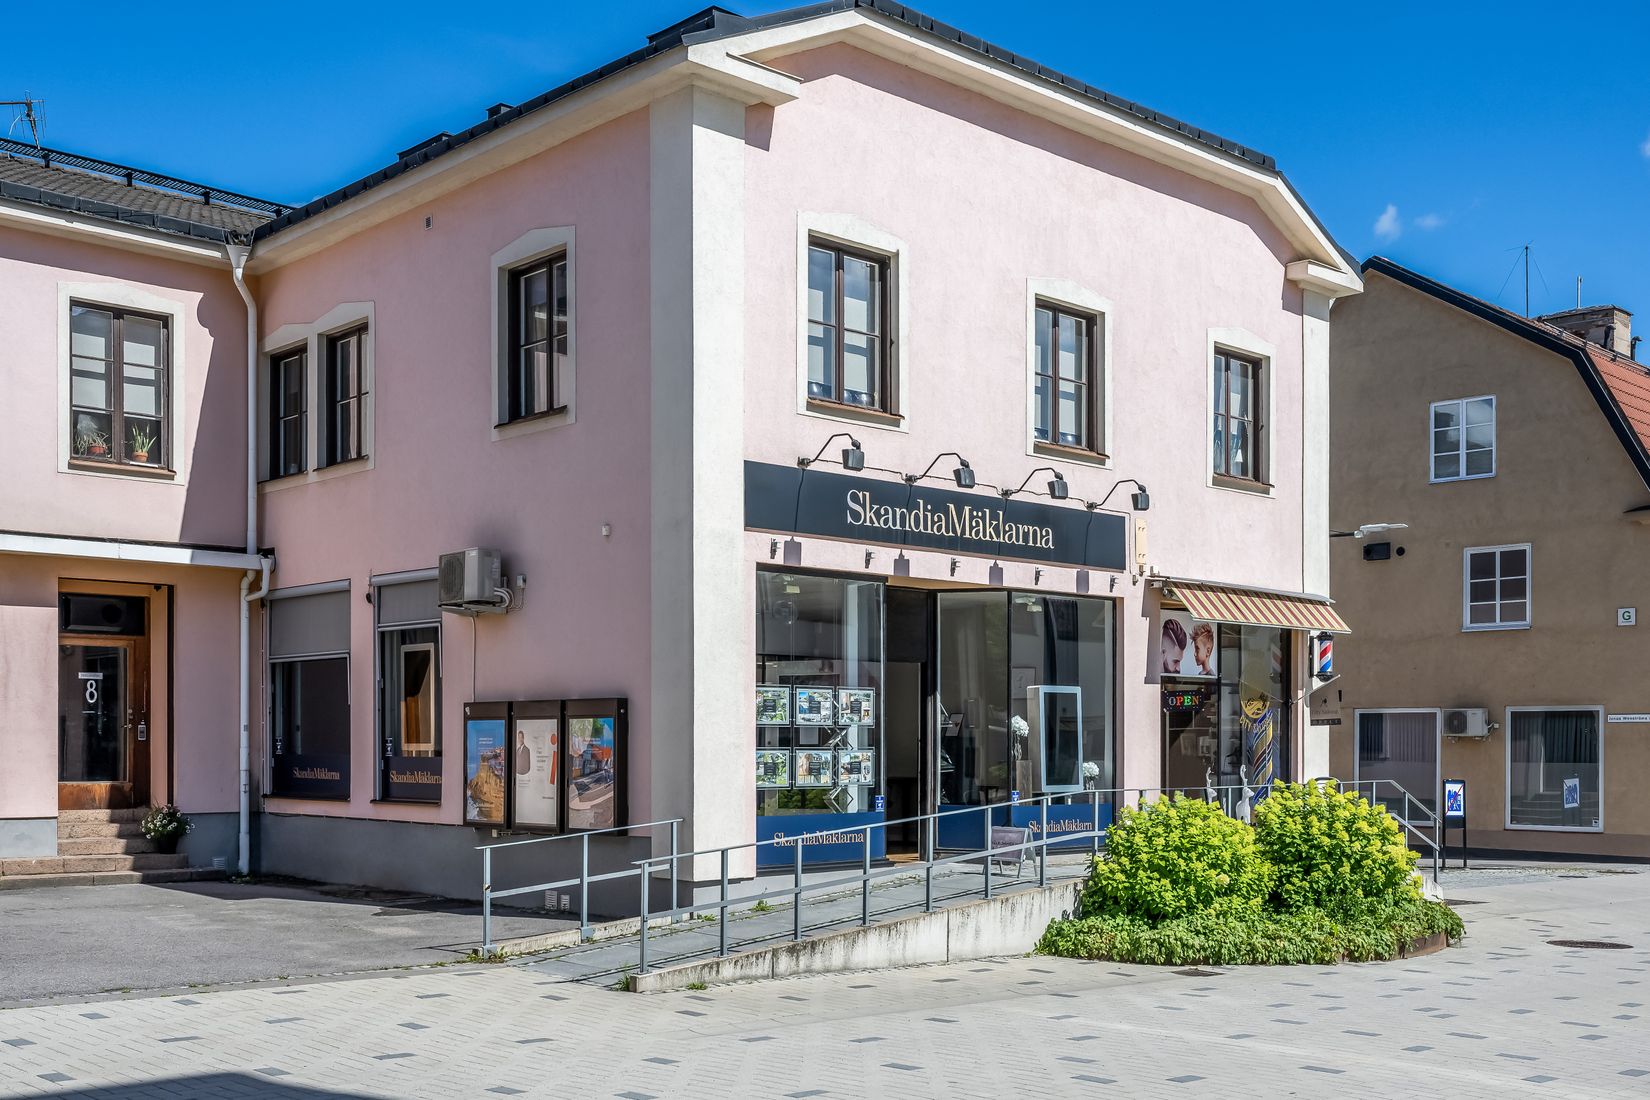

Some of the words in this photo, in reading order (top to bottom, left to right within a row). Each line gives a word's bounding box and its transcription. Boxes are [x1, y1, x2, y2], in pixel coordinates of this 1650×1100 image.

[846, 487, 1055, 549] SkandiaMäklarna
[1622, 610, 1631, 621] G
[85, 679, 98, 704] 8
[1168, 695, 1200, 706] OPEN
